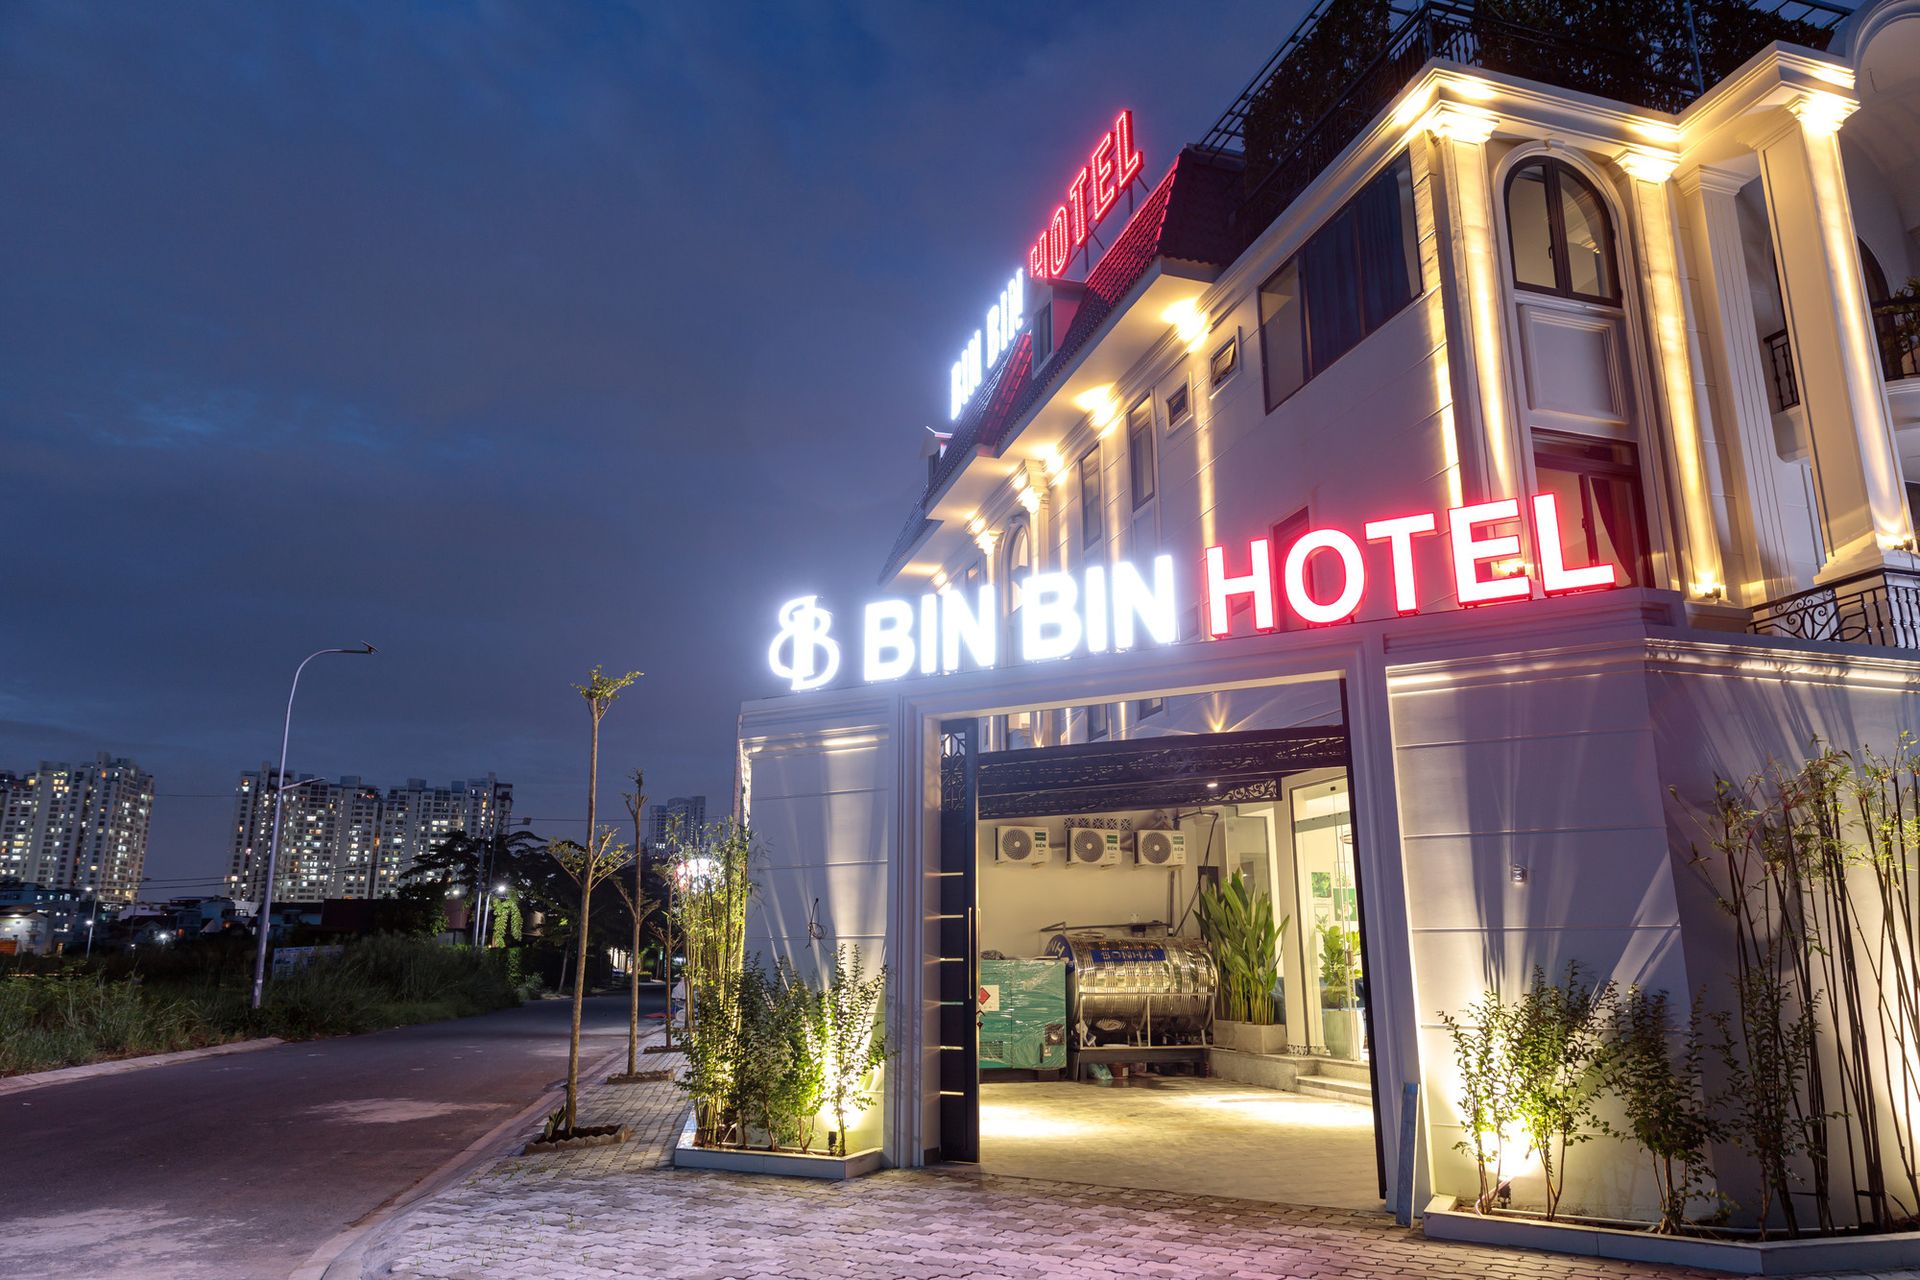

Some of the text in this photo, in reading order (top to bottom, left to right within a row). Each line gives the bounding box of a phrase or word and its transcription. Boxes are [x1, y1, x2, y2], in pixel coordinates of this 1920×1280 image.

[987, 267, 1024, 369] BIN
[1030, 110, 1143, 278] HOTEL
[864, 584, 996, 682] BIN
[1022, 554, 1176, 661] BIN
[1205, 492, 1617, 640] HOTEL
